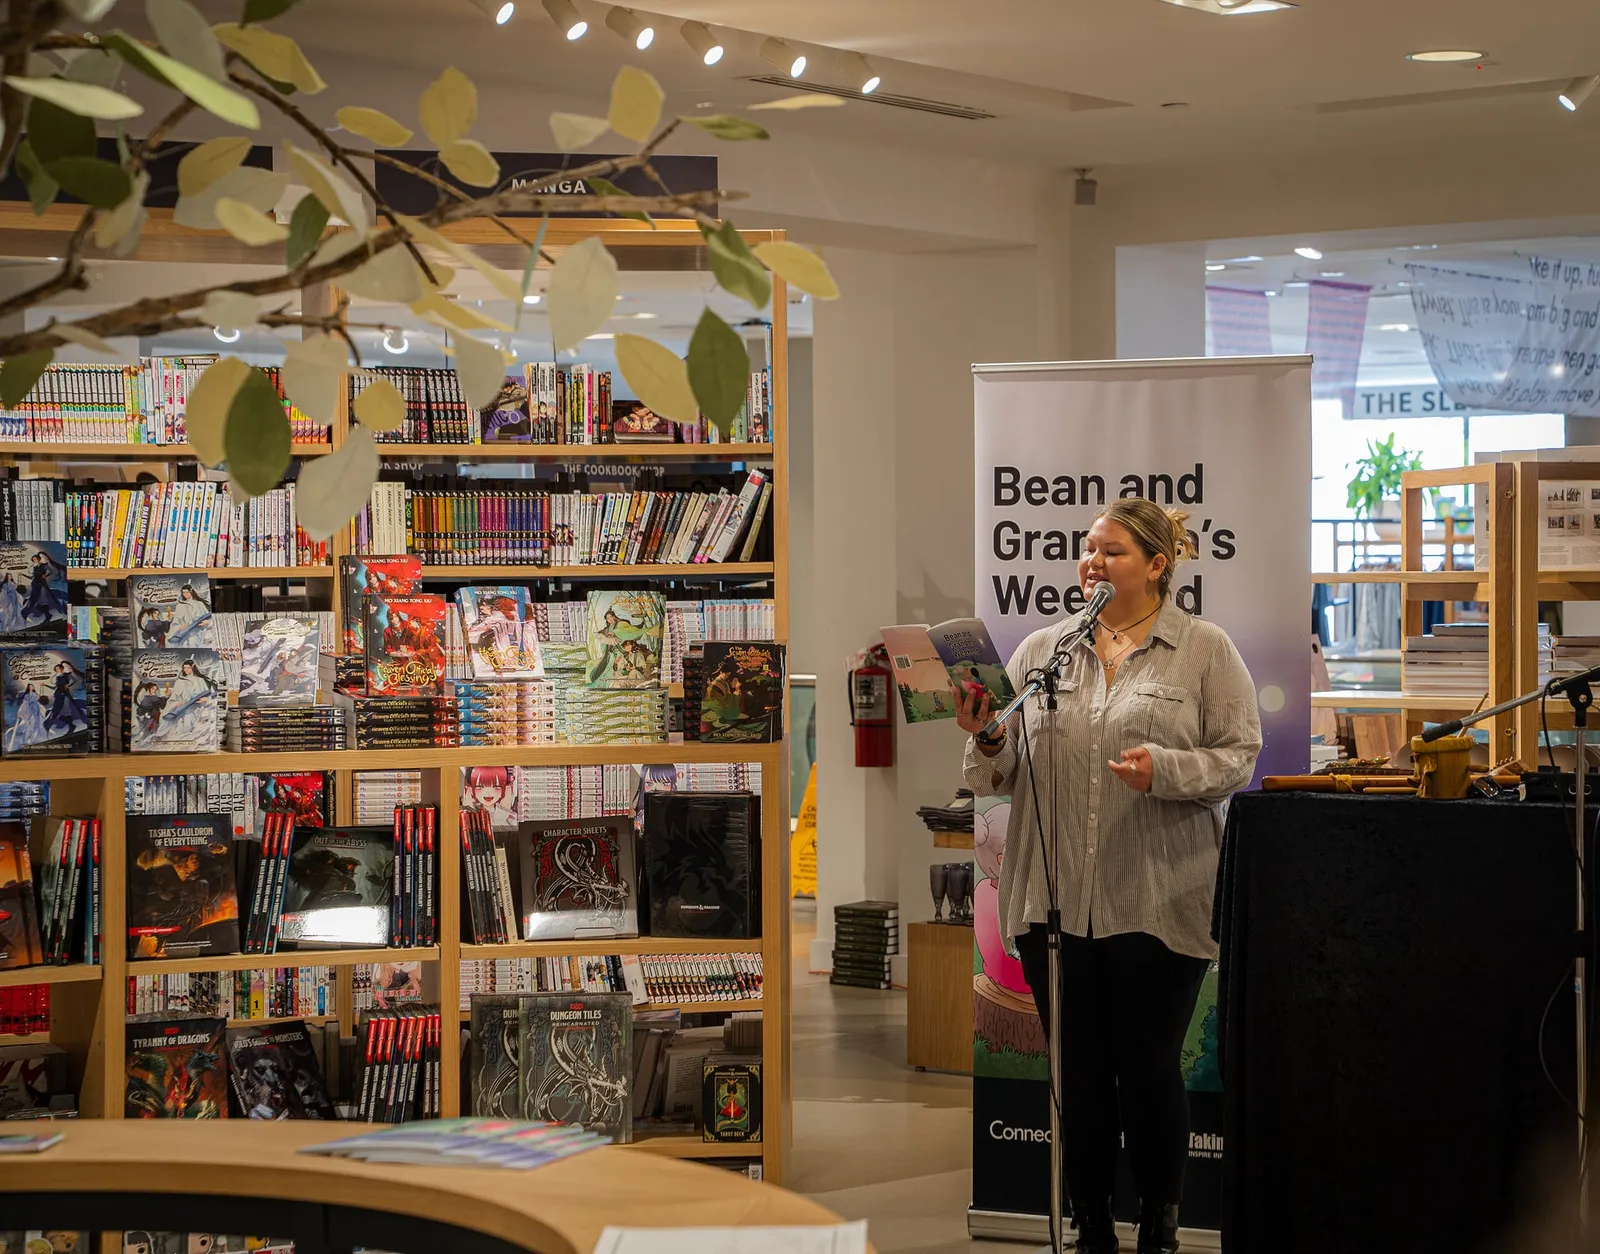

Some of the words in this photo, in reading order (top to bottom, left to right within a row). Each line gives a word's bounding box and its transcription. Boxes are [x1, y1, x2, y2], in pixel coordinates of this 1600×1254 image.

[510, 178, 587, 194] MANGA
[1361, 392, 1412, 414] THE
[564, 464, 583, 475] THE
[585, 464, 638, 476] COOKBOOK
[993, 466, 1105, 506] Bean
[1118, 463, 1203, 505] and
[992, 574, 1203, 617] Weed
[944, 632, 961, 641] Bean
[233, 793, 244, 812] GYO
[148, 828, 175, 838] TASHA'S
[177, 826, 213, 837] CAULDRON
[543, 828, 582, 837] CHARACTER
[582, 826, 607, 835] SHEETS
[164, 837, 208, 847] EVERYTHING
[314, 836, 328, 844] OUT
[347, 838, 367, 847] ABYSS
[550, 1011, 580, 1020] DUNGEON
[582, 1010, 602, 1019] TILES
[133, 1036, 167, 1048] TYRANNY
[168, 1037, 175, 1045] OF
[177, 1033, 210, 1045] DRAGONS
[275, 1032, 304, 1043] MONSTERS
